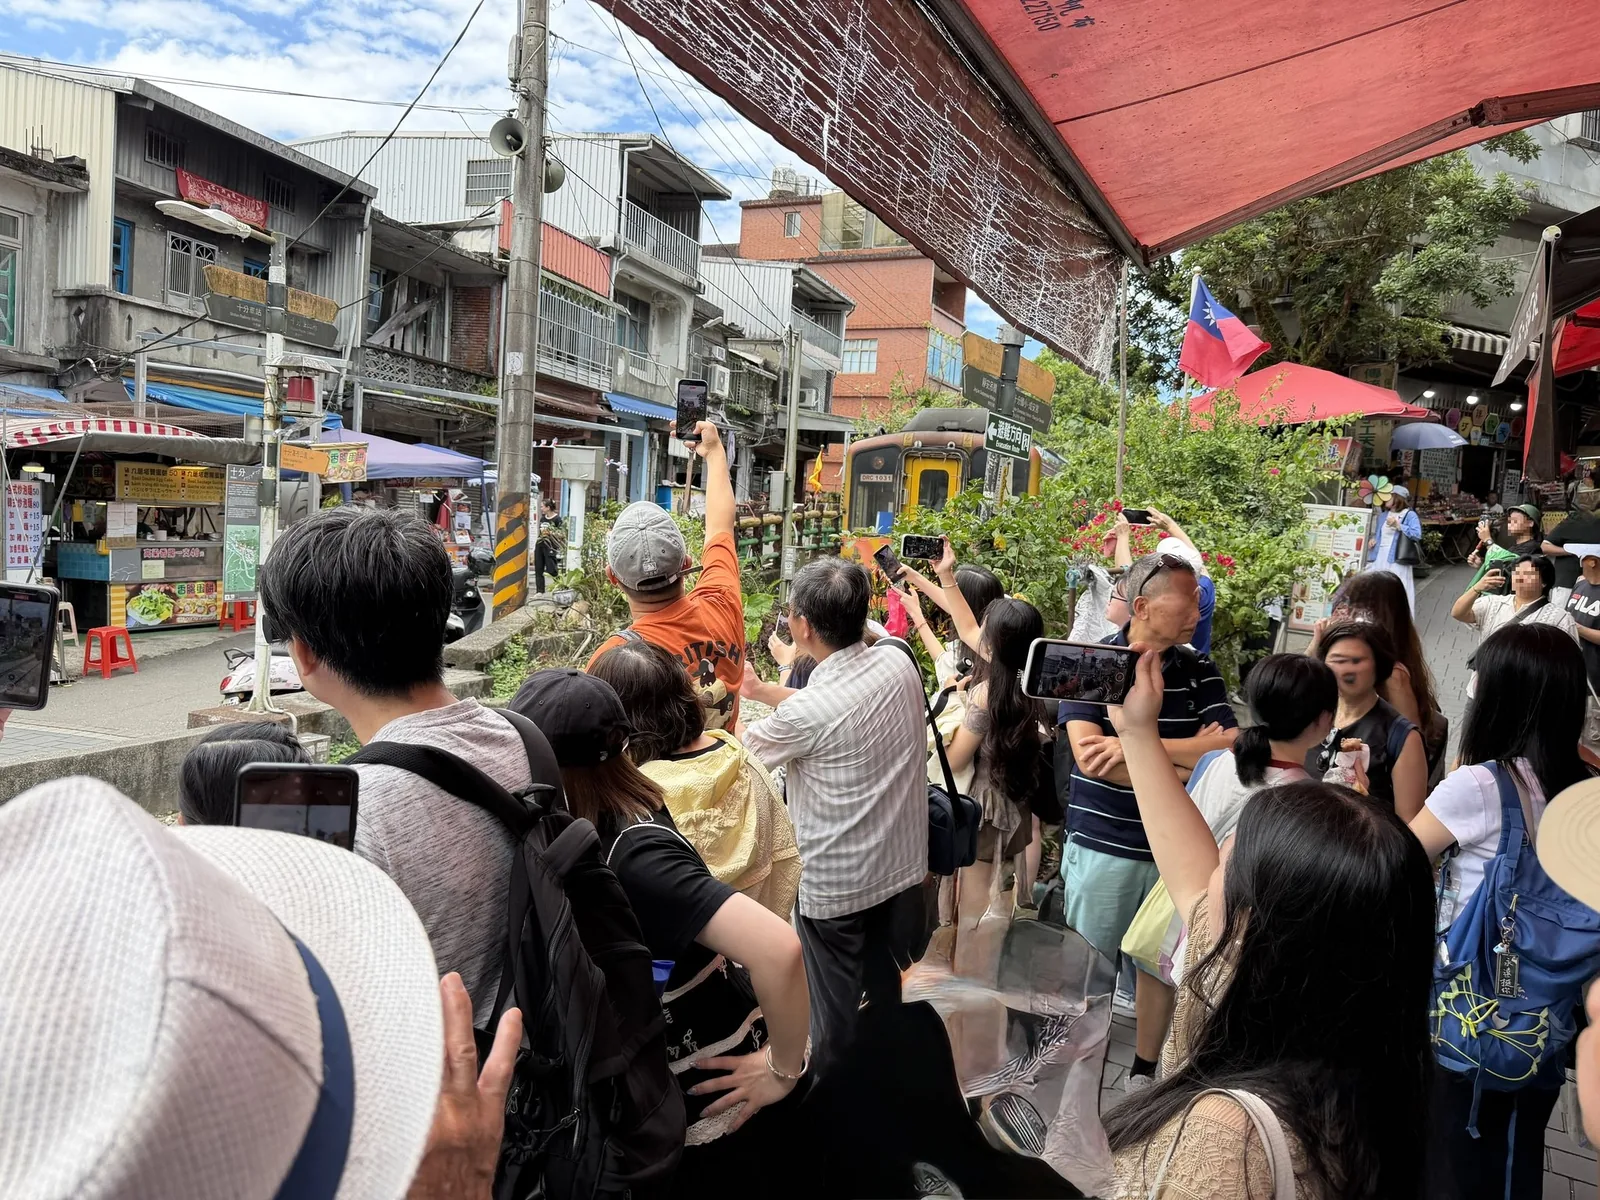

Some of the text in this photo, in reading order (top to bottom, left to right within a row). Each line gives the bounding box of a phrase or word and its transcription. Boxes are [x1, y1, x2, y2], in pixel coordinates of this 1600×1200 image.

[997, 420, 1022, 444] 避難方向
[33, 488, 39, 496] 50
[33, 500, 40, 509] 80
[29, 534, 40, 542] +25
[1567, 595, 1600, 617] FILA
